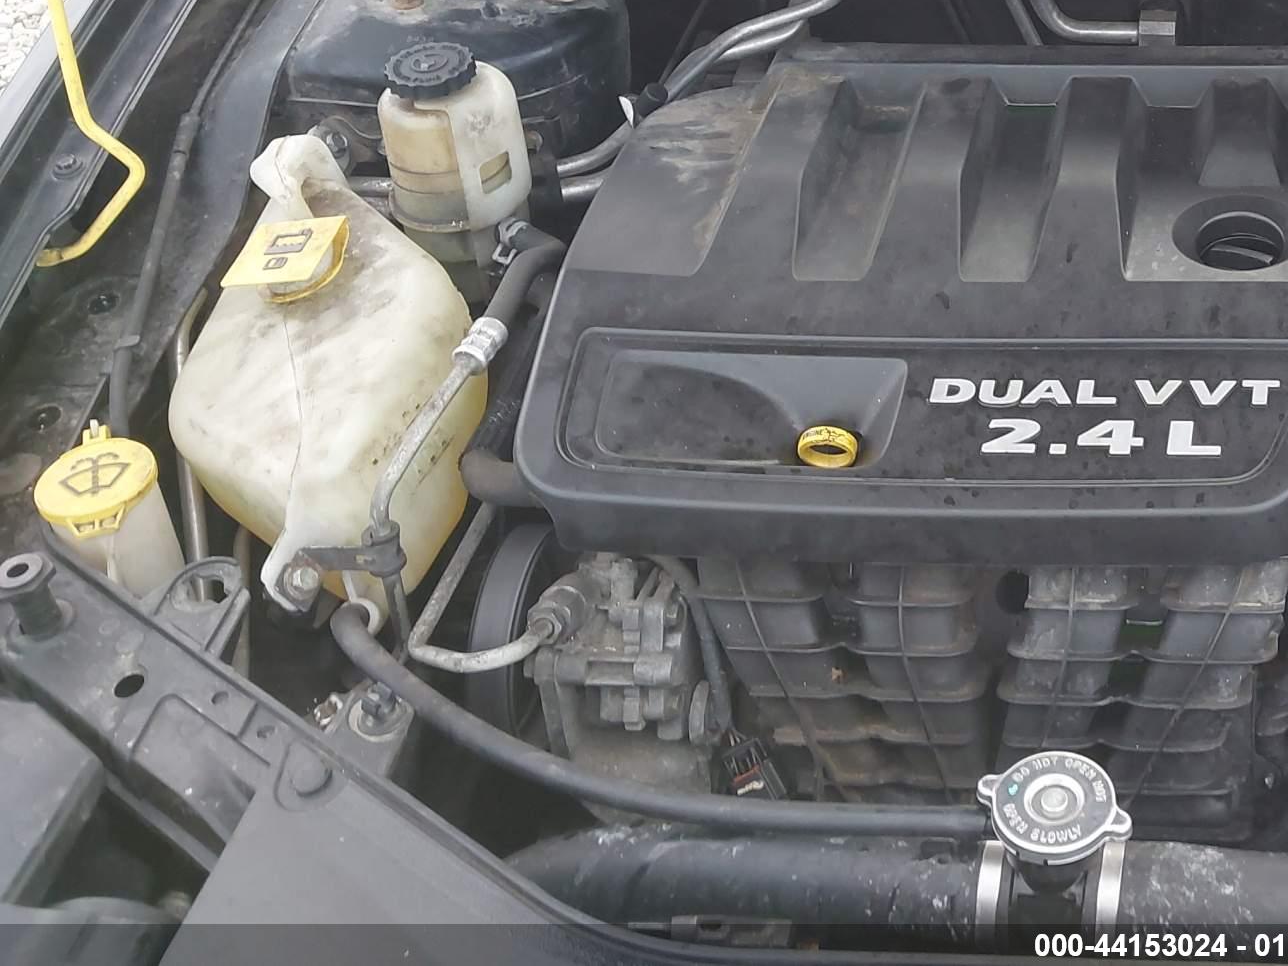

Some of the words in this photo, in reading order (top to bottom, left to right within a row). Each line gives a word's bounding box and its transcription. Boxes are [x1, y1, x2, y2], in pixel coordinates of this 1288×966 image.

[926, 378, 1117, 406] DUAL
[1135, 379, 1281, 406] VVT
[981, 418, 1144, 455] 2.4
[1011, 767, 1030, 782] DO
[1032, 756, 1058, 771] NOT
[1065, 758, 1097, 781] OPEN
[1030, 824, 1081, 844] SLOWLY
